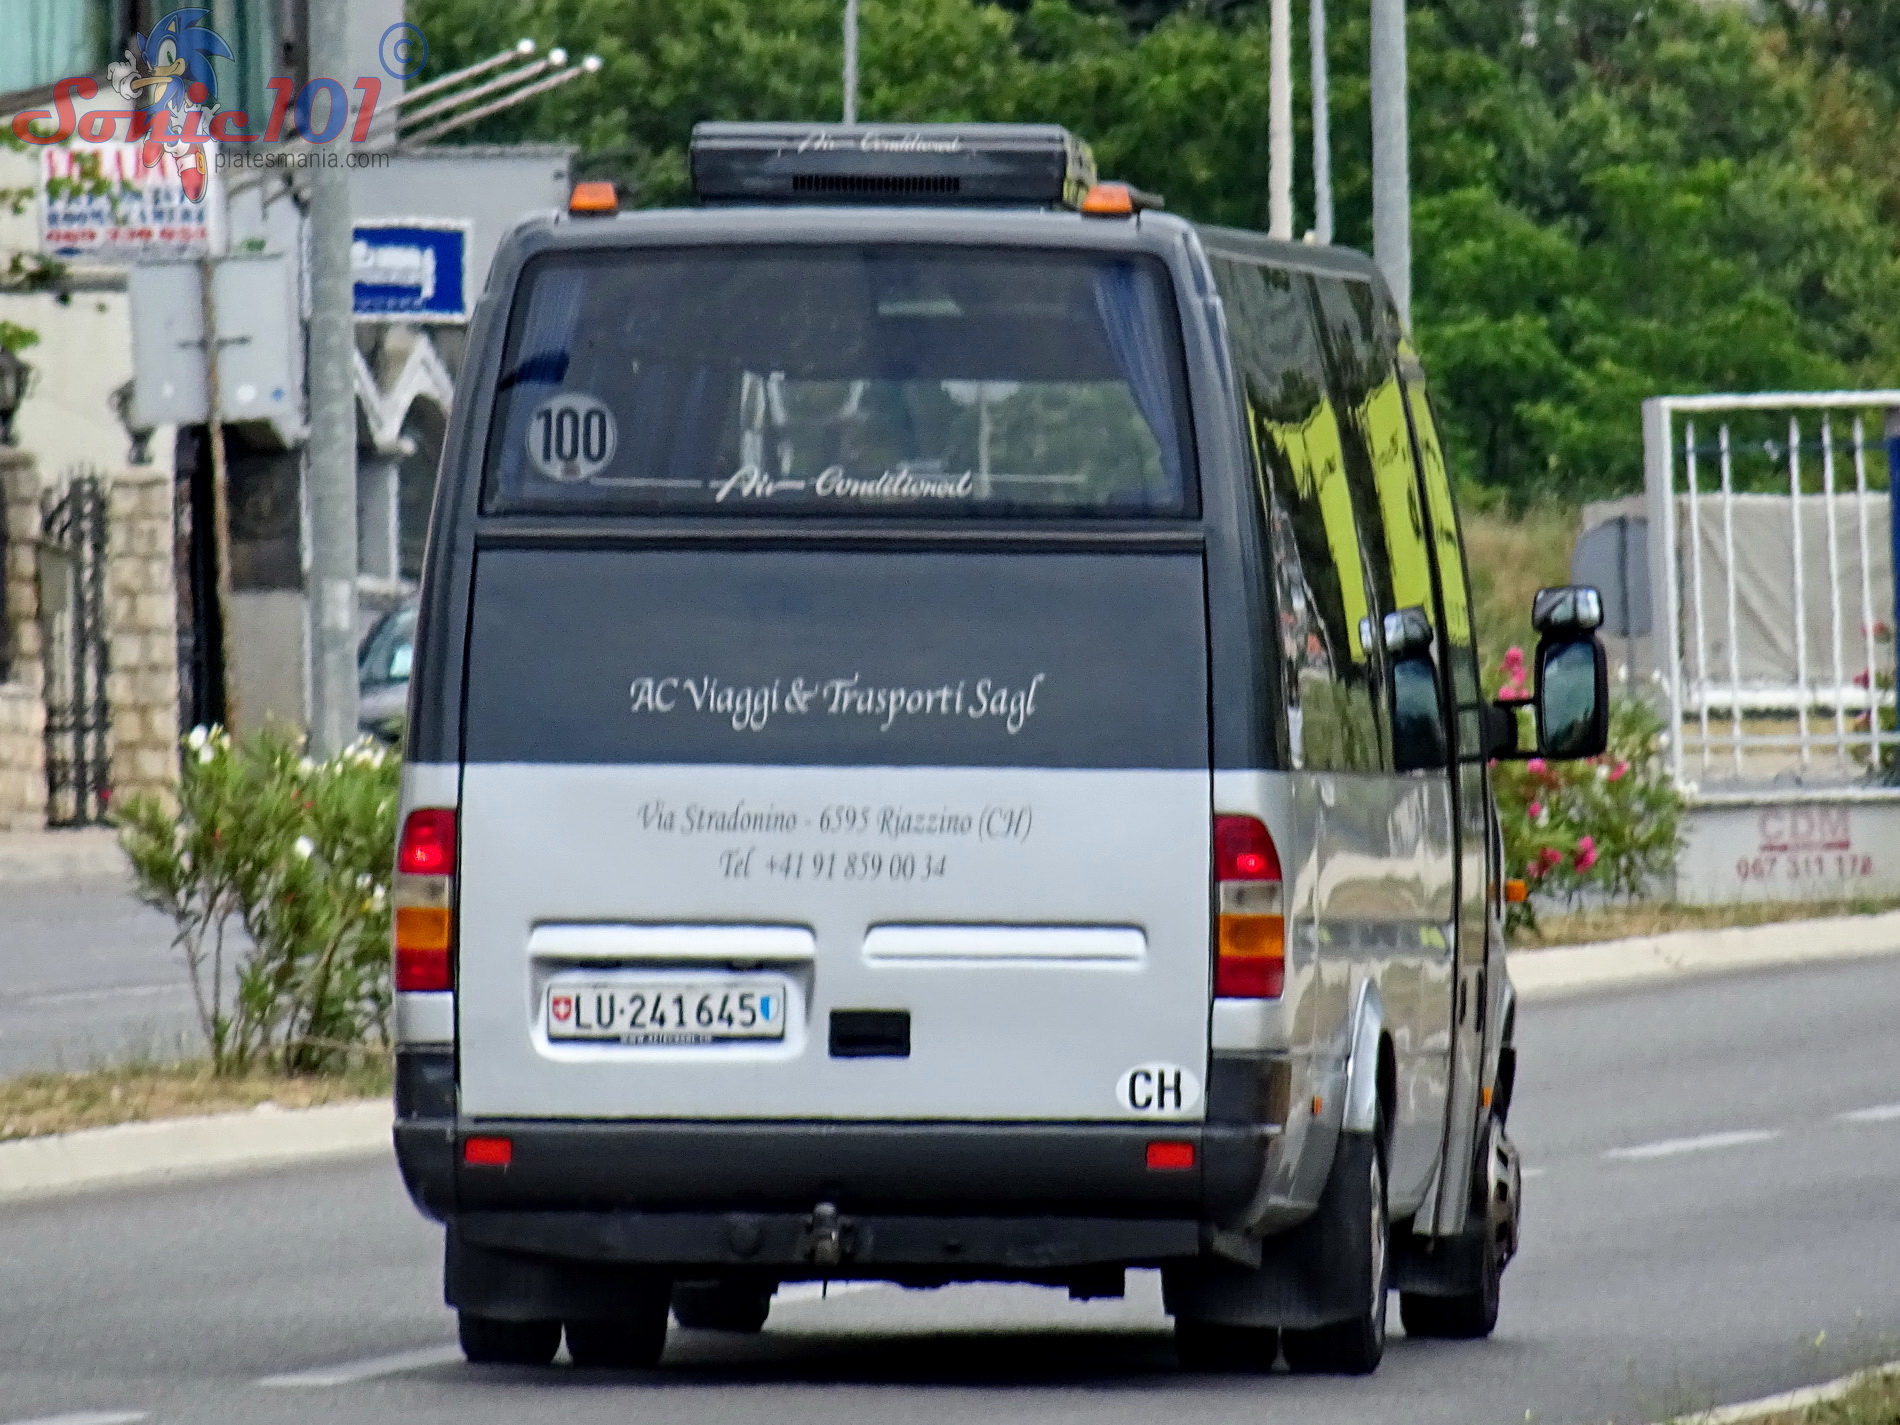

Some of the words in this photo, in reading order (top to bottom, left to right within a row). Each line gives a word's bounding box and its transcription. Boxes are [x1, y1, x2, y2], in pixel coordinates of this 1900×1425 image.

[536, 407, 607, 464] 100
[630, 676, 679, 713] AC
[683, 675, 780, 732] Viaggi
[784, 677, 819, 714] &
[823, 672, 965, 732] Trasporti
[968, 672, 1046, 735] Sagl
[638, 798, 676, 831] Via
[681, 799, 797, 835] Stradonino
[820, 805, 870, 833] 6595
[877, 803, 973, 841] Riazzino
[979, 802, 1033, 844] (CH)
[766, 851, 803, 879] +41
[812, 851, 836, 880] 91
[844, 852, 882, 881] 859
[889, 853, 915, 881] 00
[920, 853, 946, 882] 34
[1129, 1069, 1182, 1110] CH
